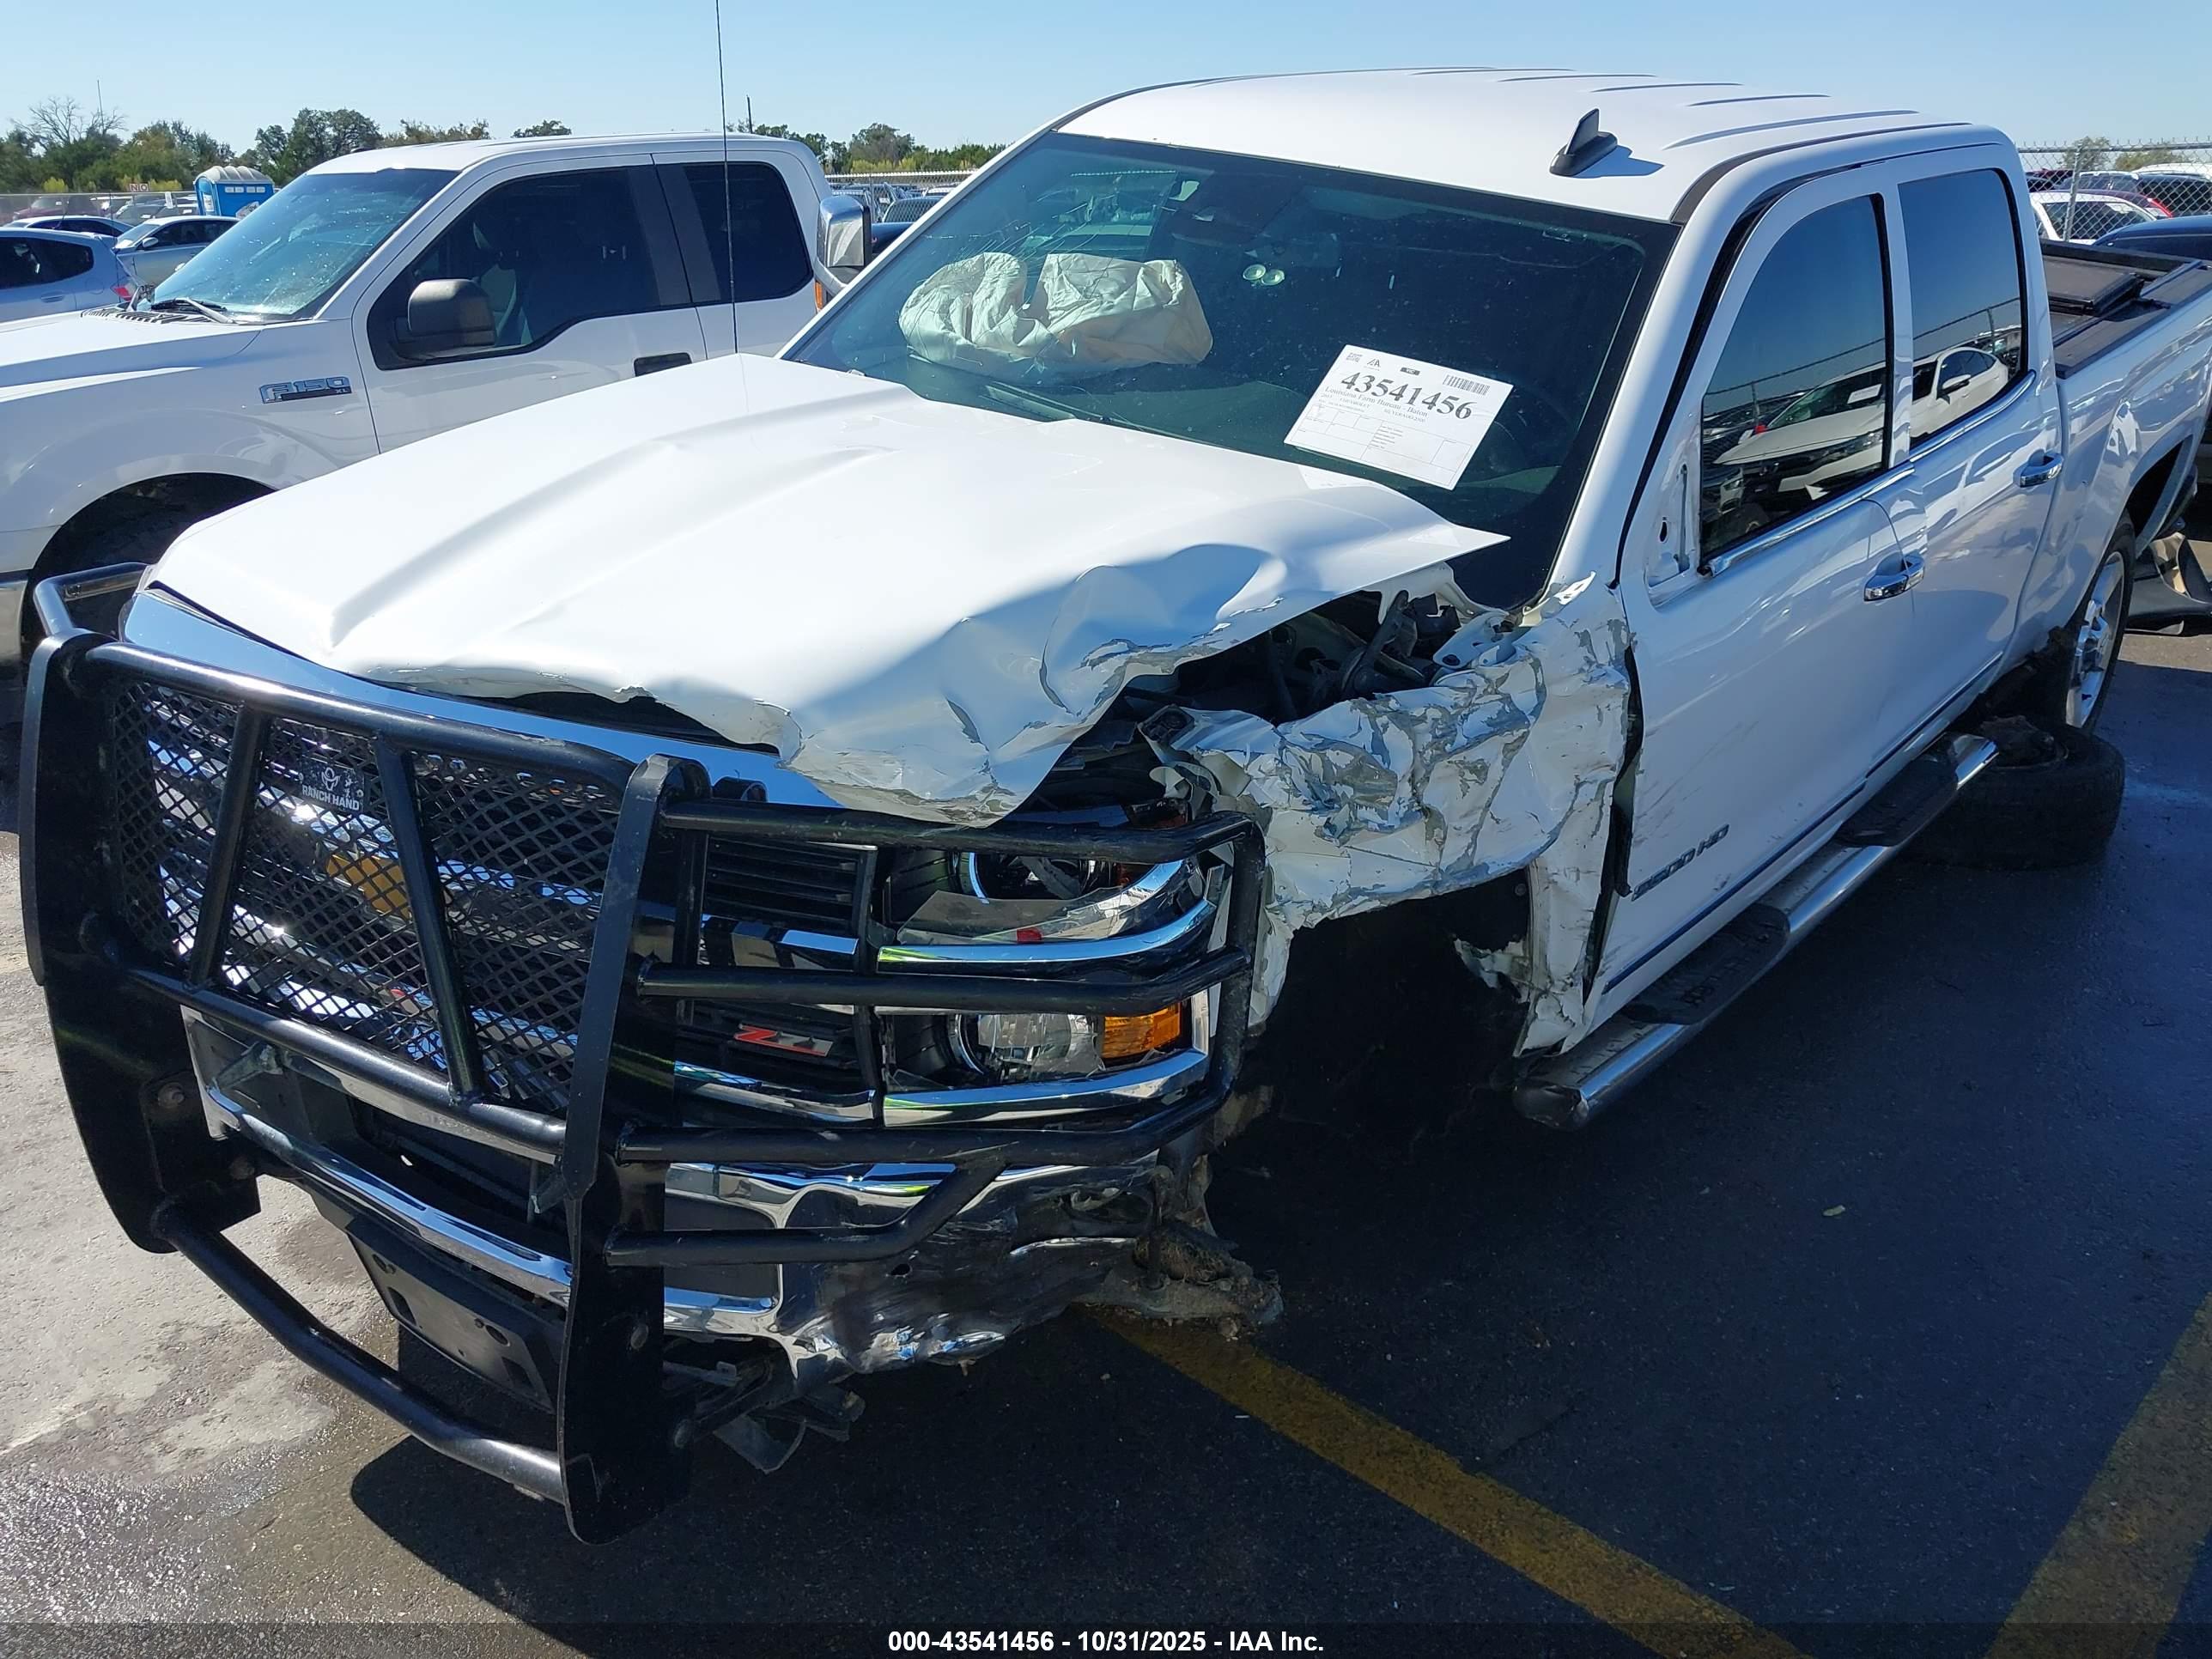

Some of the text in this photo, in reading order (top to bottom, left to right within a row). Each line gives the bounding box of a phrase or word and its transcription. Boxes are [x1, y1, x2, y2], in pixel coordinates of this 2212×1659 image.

[130, 183, 149, 191] NO
[1324, 386, 1358, 398] Louisiana
[1358, 393, 1376, 405] Farm
[1376, 398, 1402, 410] Bureau
[1407, 406, 1428, 417] Baton
[1340, 372, 1479, 420] 43541456
[301, 784, 361, 811] RANCH HAND
[1696, 823, 1730, 857] HD
[733, 1023, 834, 1057] Z71
